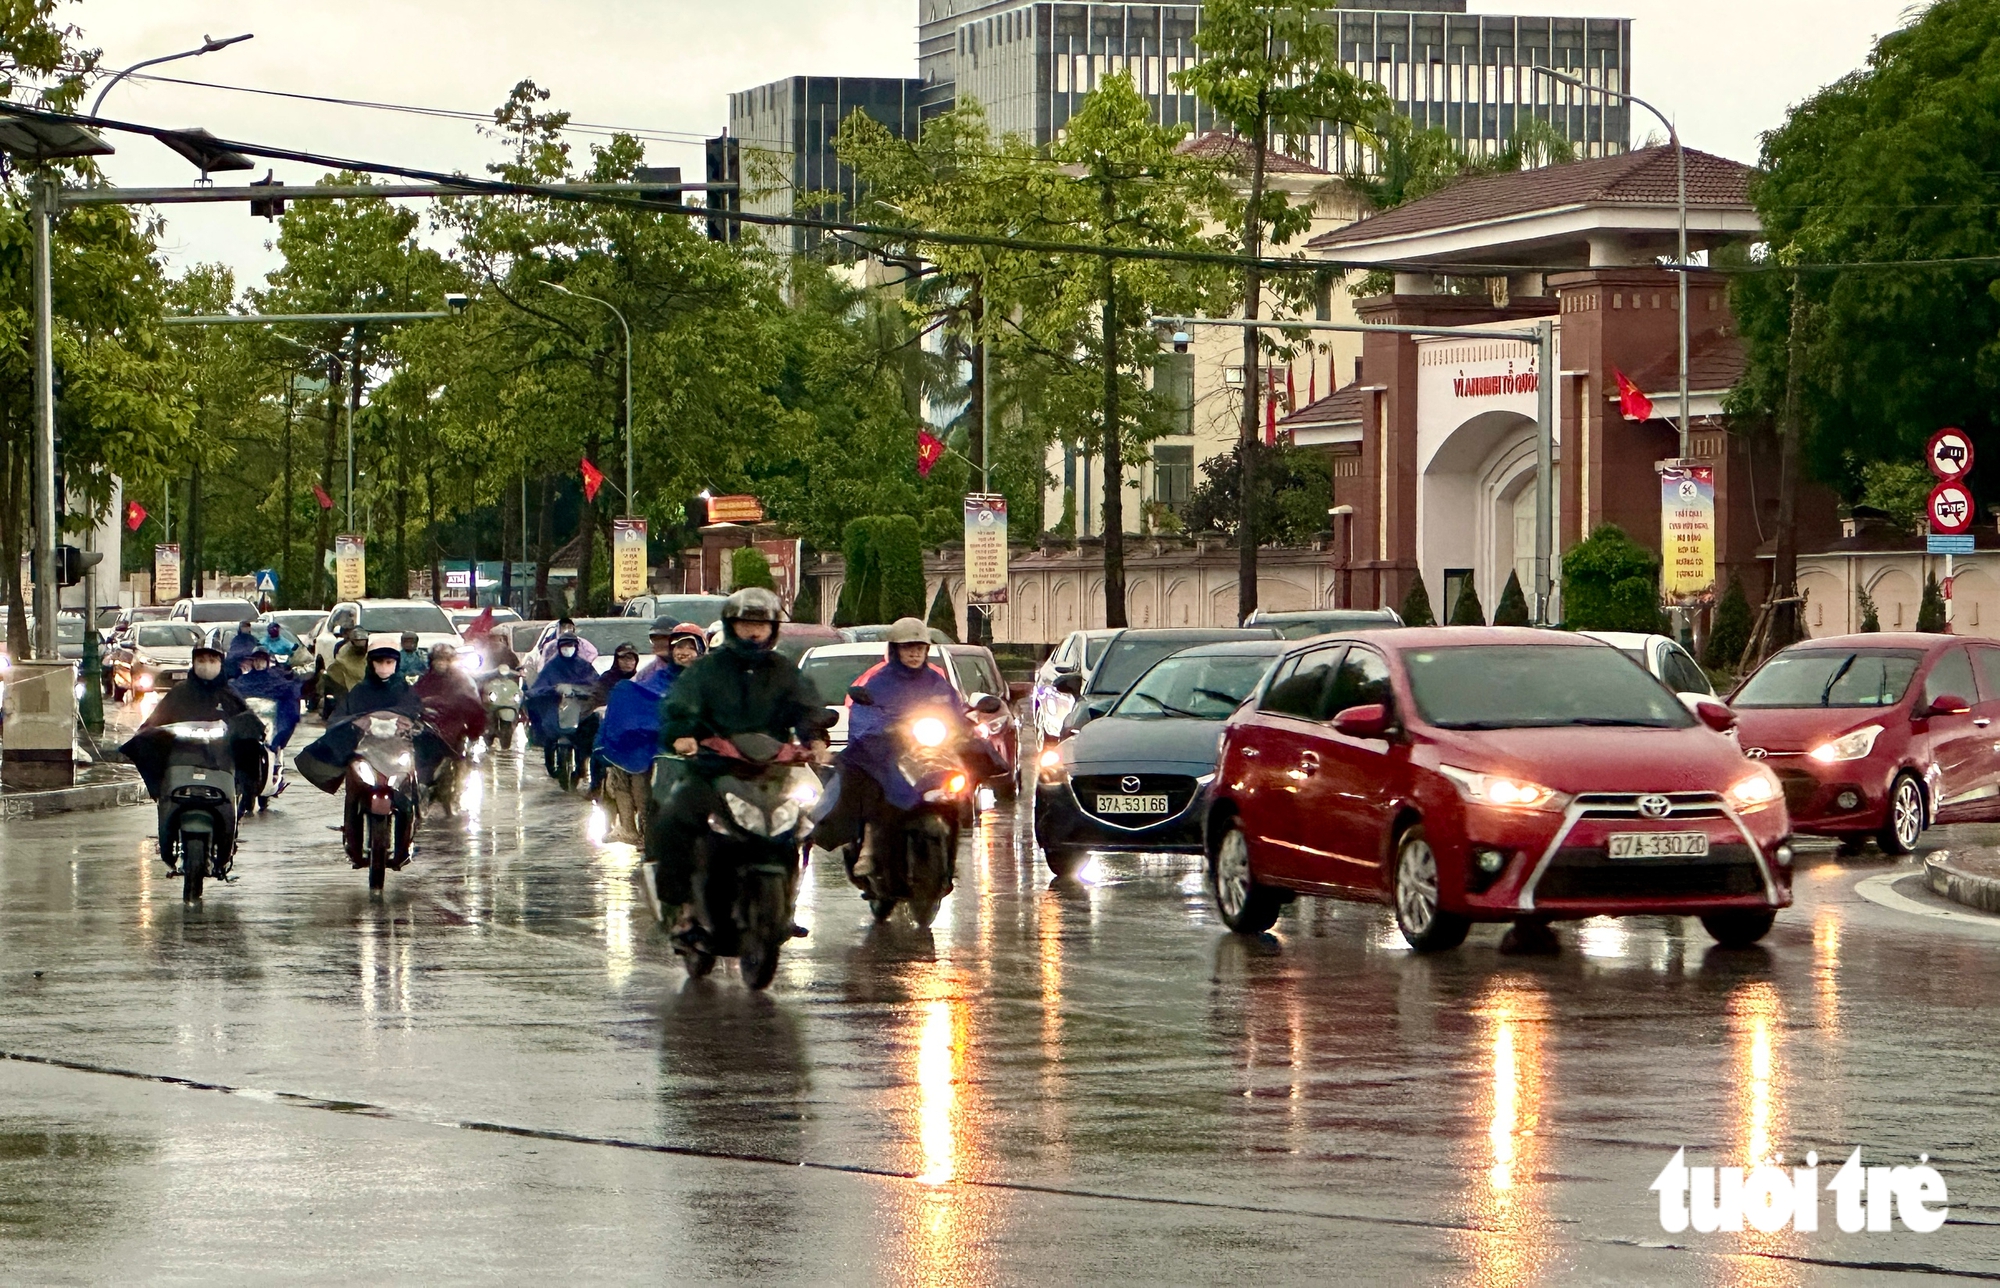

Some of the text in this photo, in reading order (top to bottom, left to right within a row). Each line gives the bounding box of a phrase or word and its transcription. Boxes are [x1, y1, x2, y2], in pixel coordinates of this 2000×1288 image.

[1453, 369, 1464, 397] VÌ
[1502, 361, 1514, 395] TỔ
[447, 575, 464, 584] ATM
